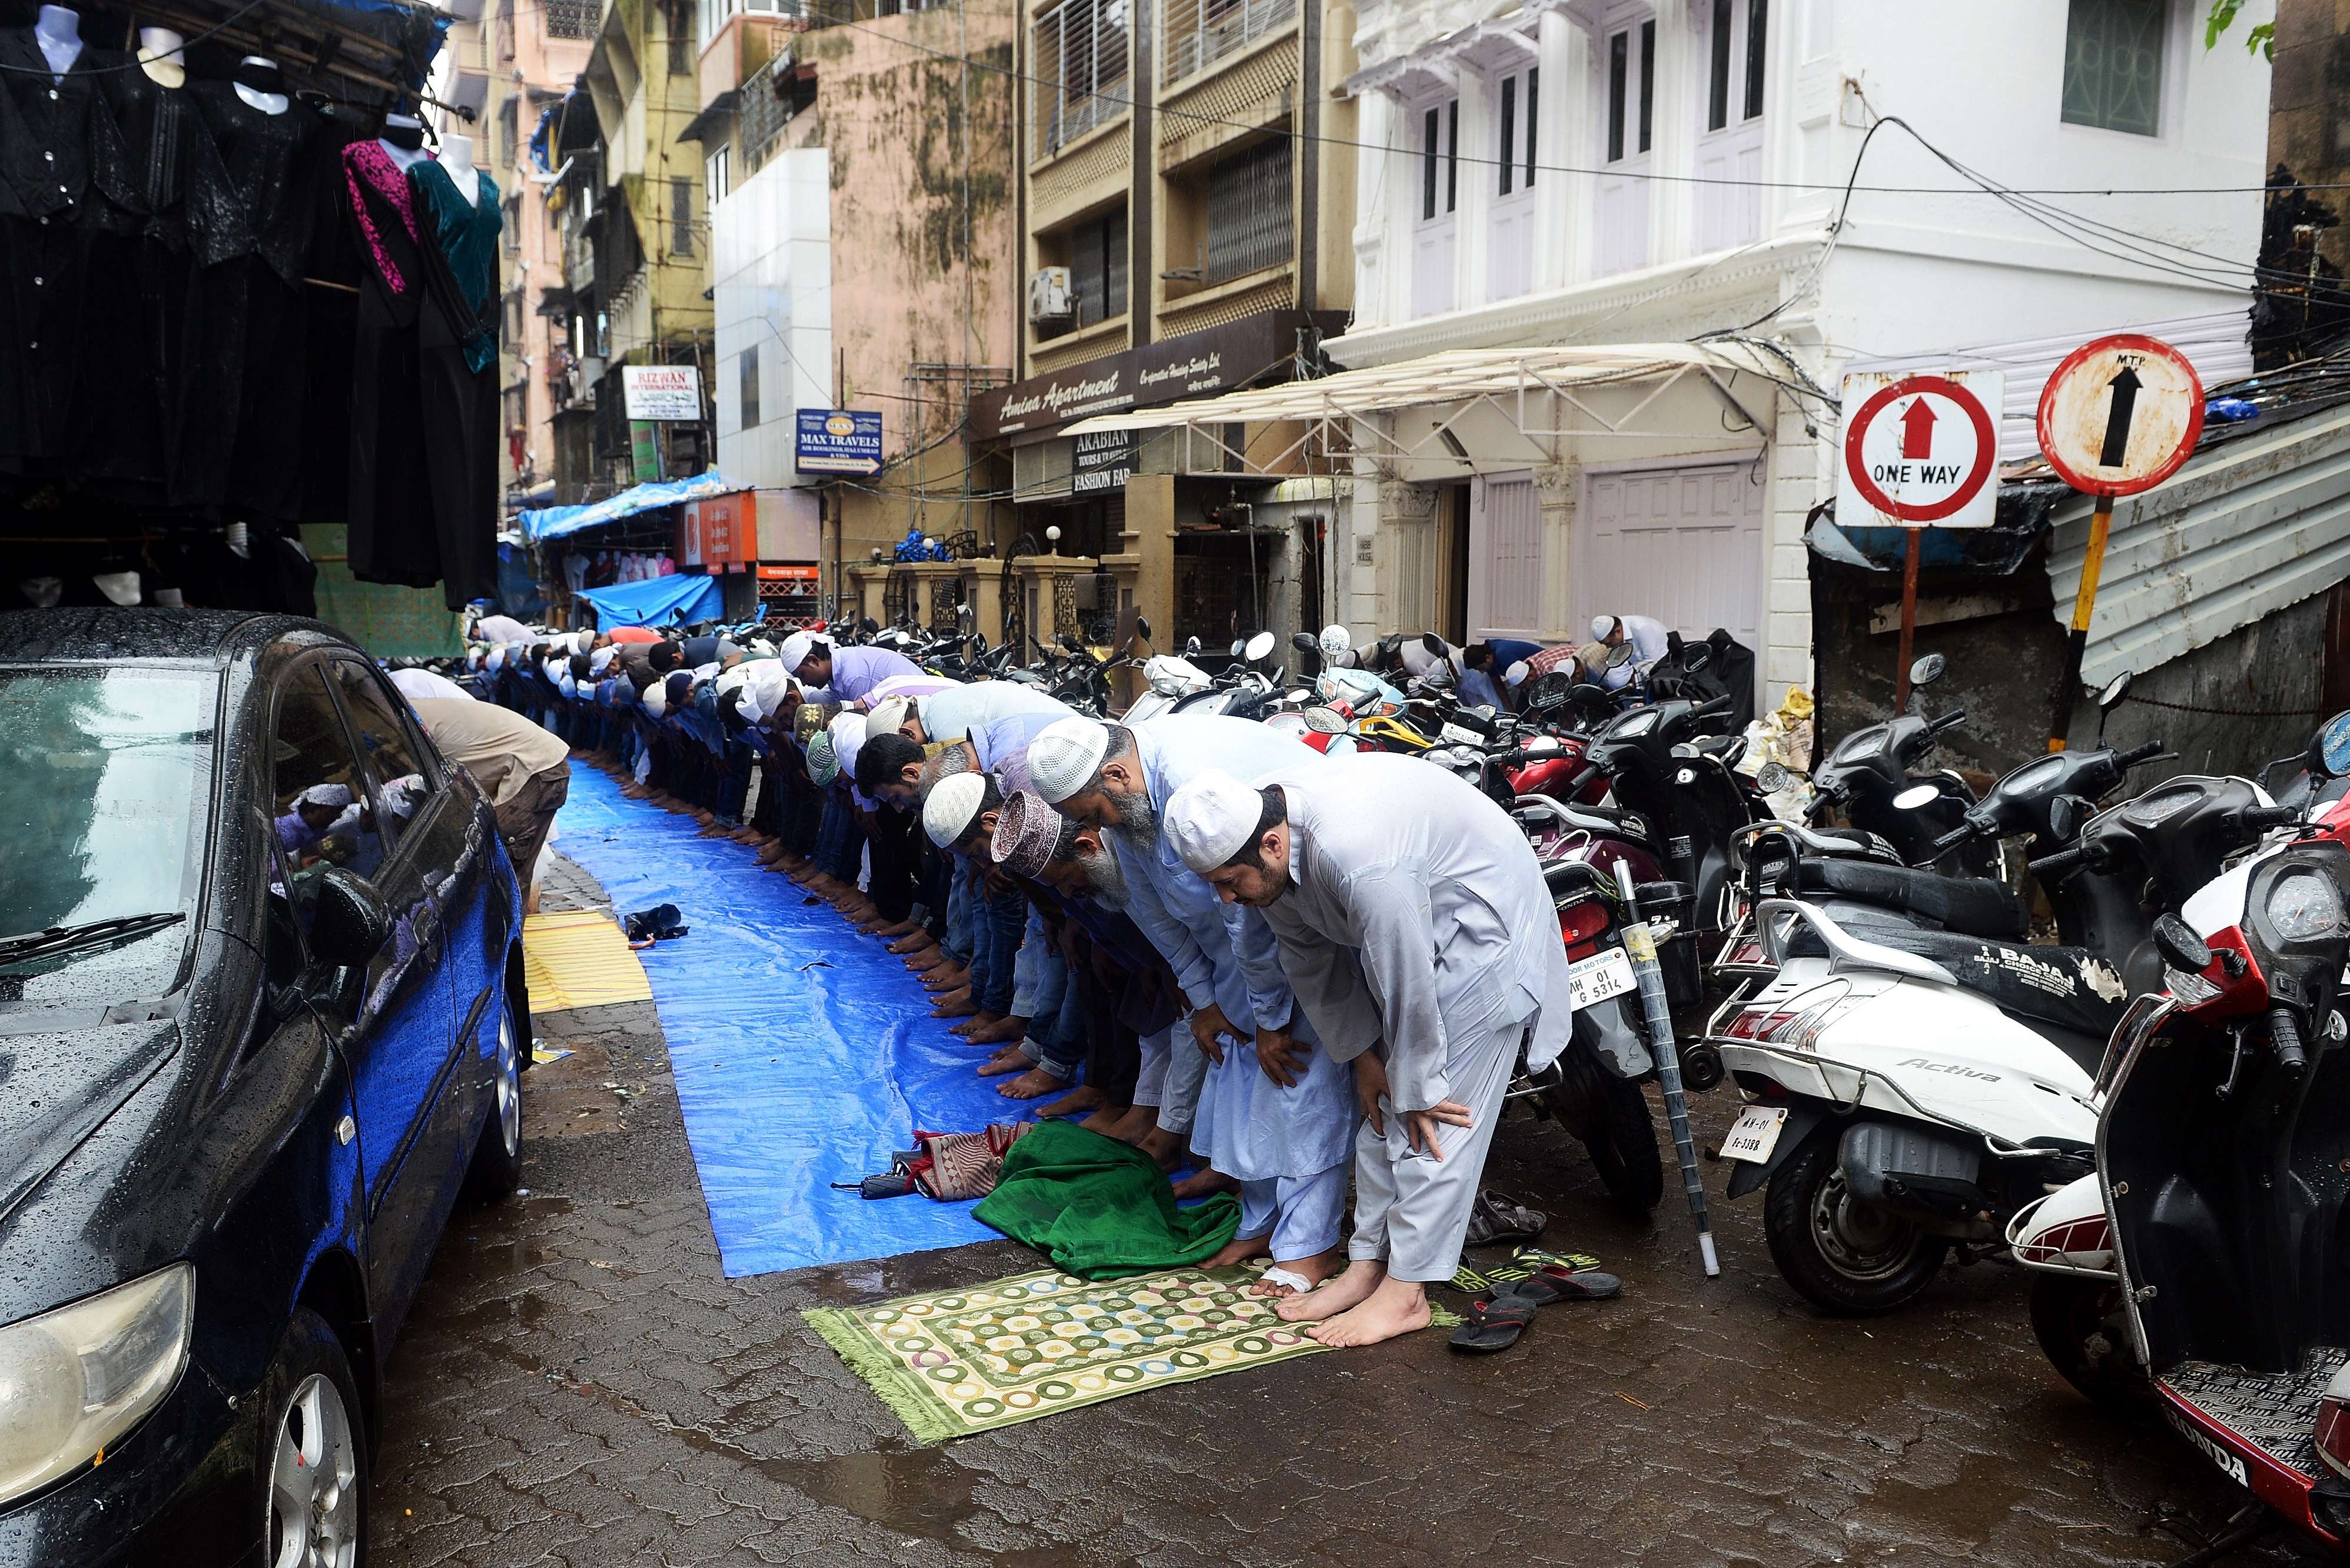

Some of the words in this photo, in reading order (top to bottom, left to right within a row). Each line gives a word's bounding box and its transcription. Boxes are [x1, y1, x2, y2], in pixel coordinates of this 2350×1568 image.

[638, 372, 686, 383] RIZWAN
[1000, 394, 1041, 421] Amina
[1041, 370, 1119, 413] Apartment
[801, 433, 828, 444] MAX
[829, 435, 879, 447] TRAVELS
[1076, 430, 1128, 453] ARABIAN
[1074, 471, 1111, 491] FASHION
[1874, 465, 1911, 482] ONE
[1921, 466, 1961, 484] WAY
[1559, 899, 1585, 911] ONDA
[1584, 954, 1613, 970] MOTORS
[1974, 955, 1999, 964] BAJAJ
[2000, 947, 2075, 986] BAJAJ
[2004, 959, 2042, 974] CHOICE
[1596, 969, 1609, 982] 01
[1579, 992, 1586, 1002] G
[1592, 979, 1621, 998] 5314
[1896, 1058, 2002, 1082] Activa
[2161, 1403, 2249, 1488] HONDA
